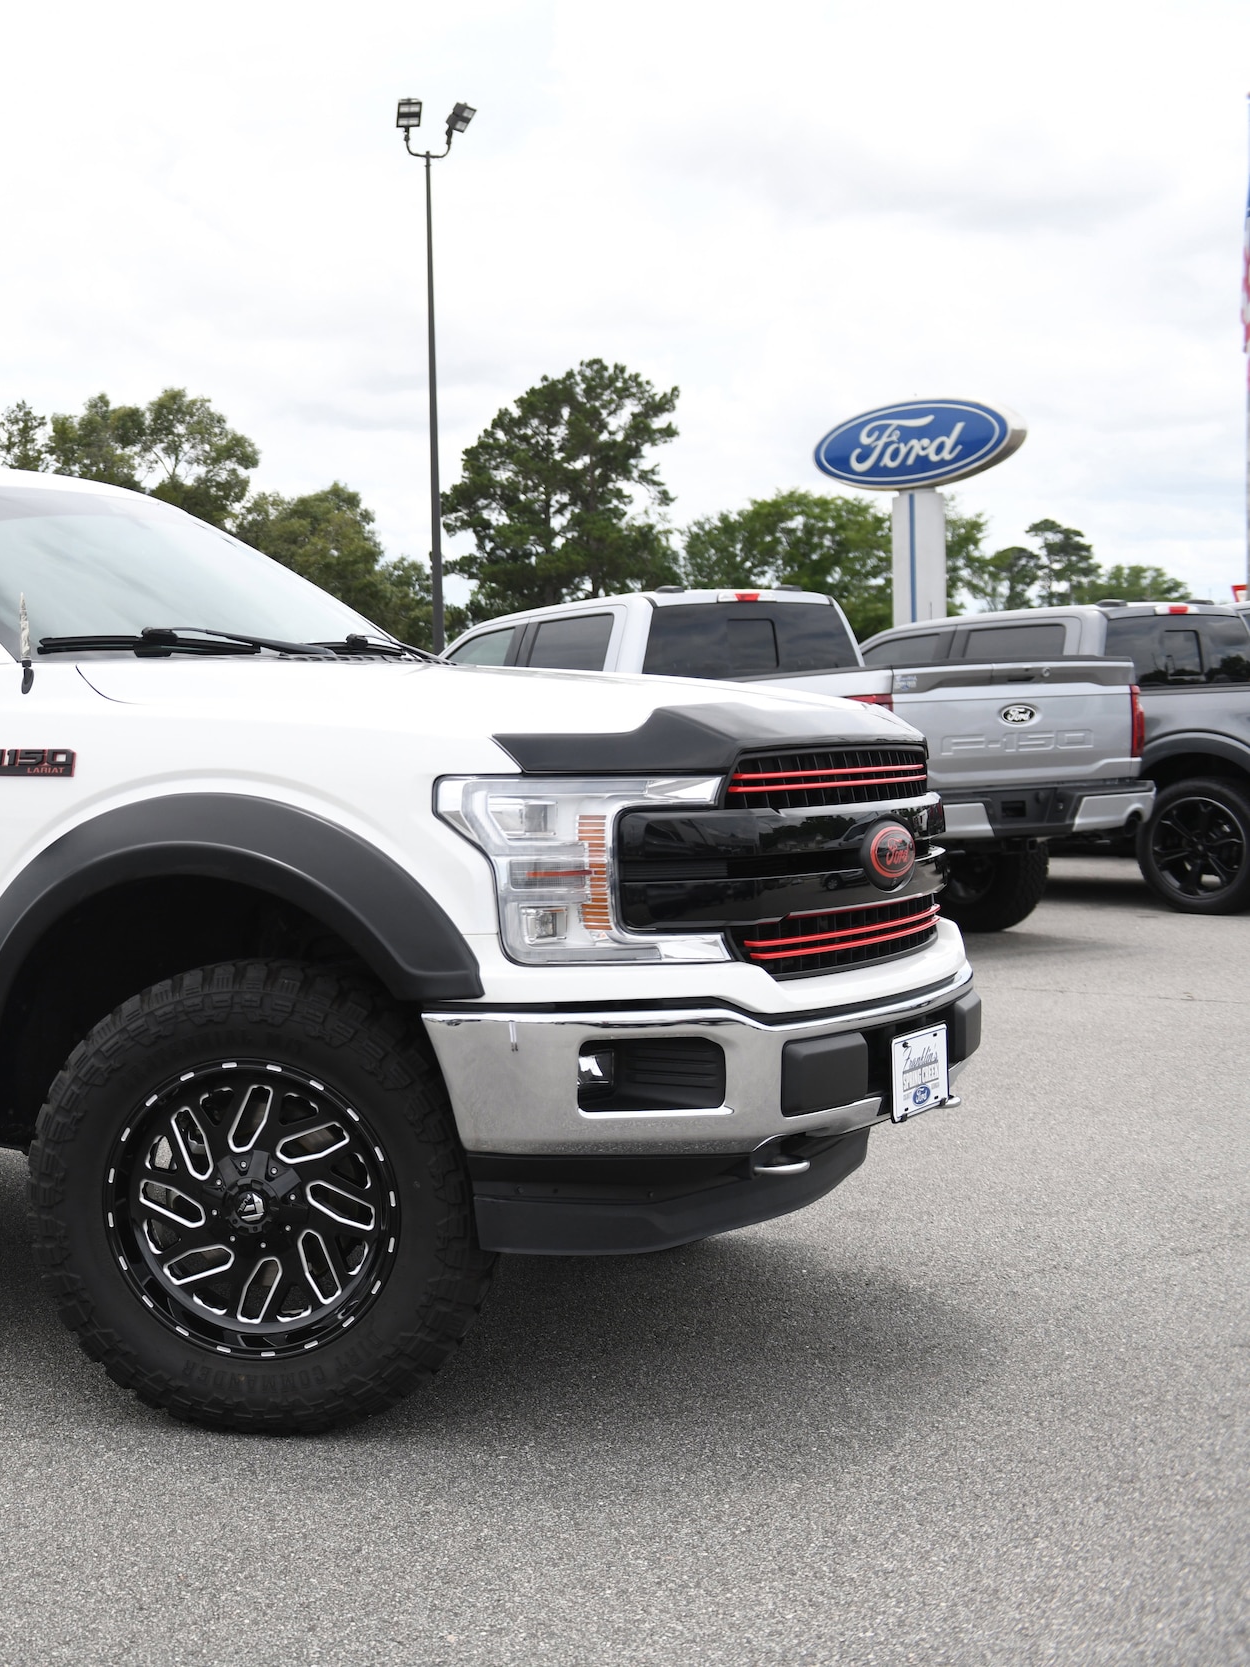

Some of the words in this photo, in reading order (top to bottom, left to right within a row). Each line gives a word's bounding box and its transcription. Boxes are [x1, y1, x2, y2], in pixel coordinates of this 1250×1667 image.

[850, 414, 966, 473] Ford
[1007, 707, 1031, 722] Ford
[941, 728, 1094, 756] F-150
[885, 837, 910, 866] Ford
[181, 1359, 327, 1394] COMMANDER
